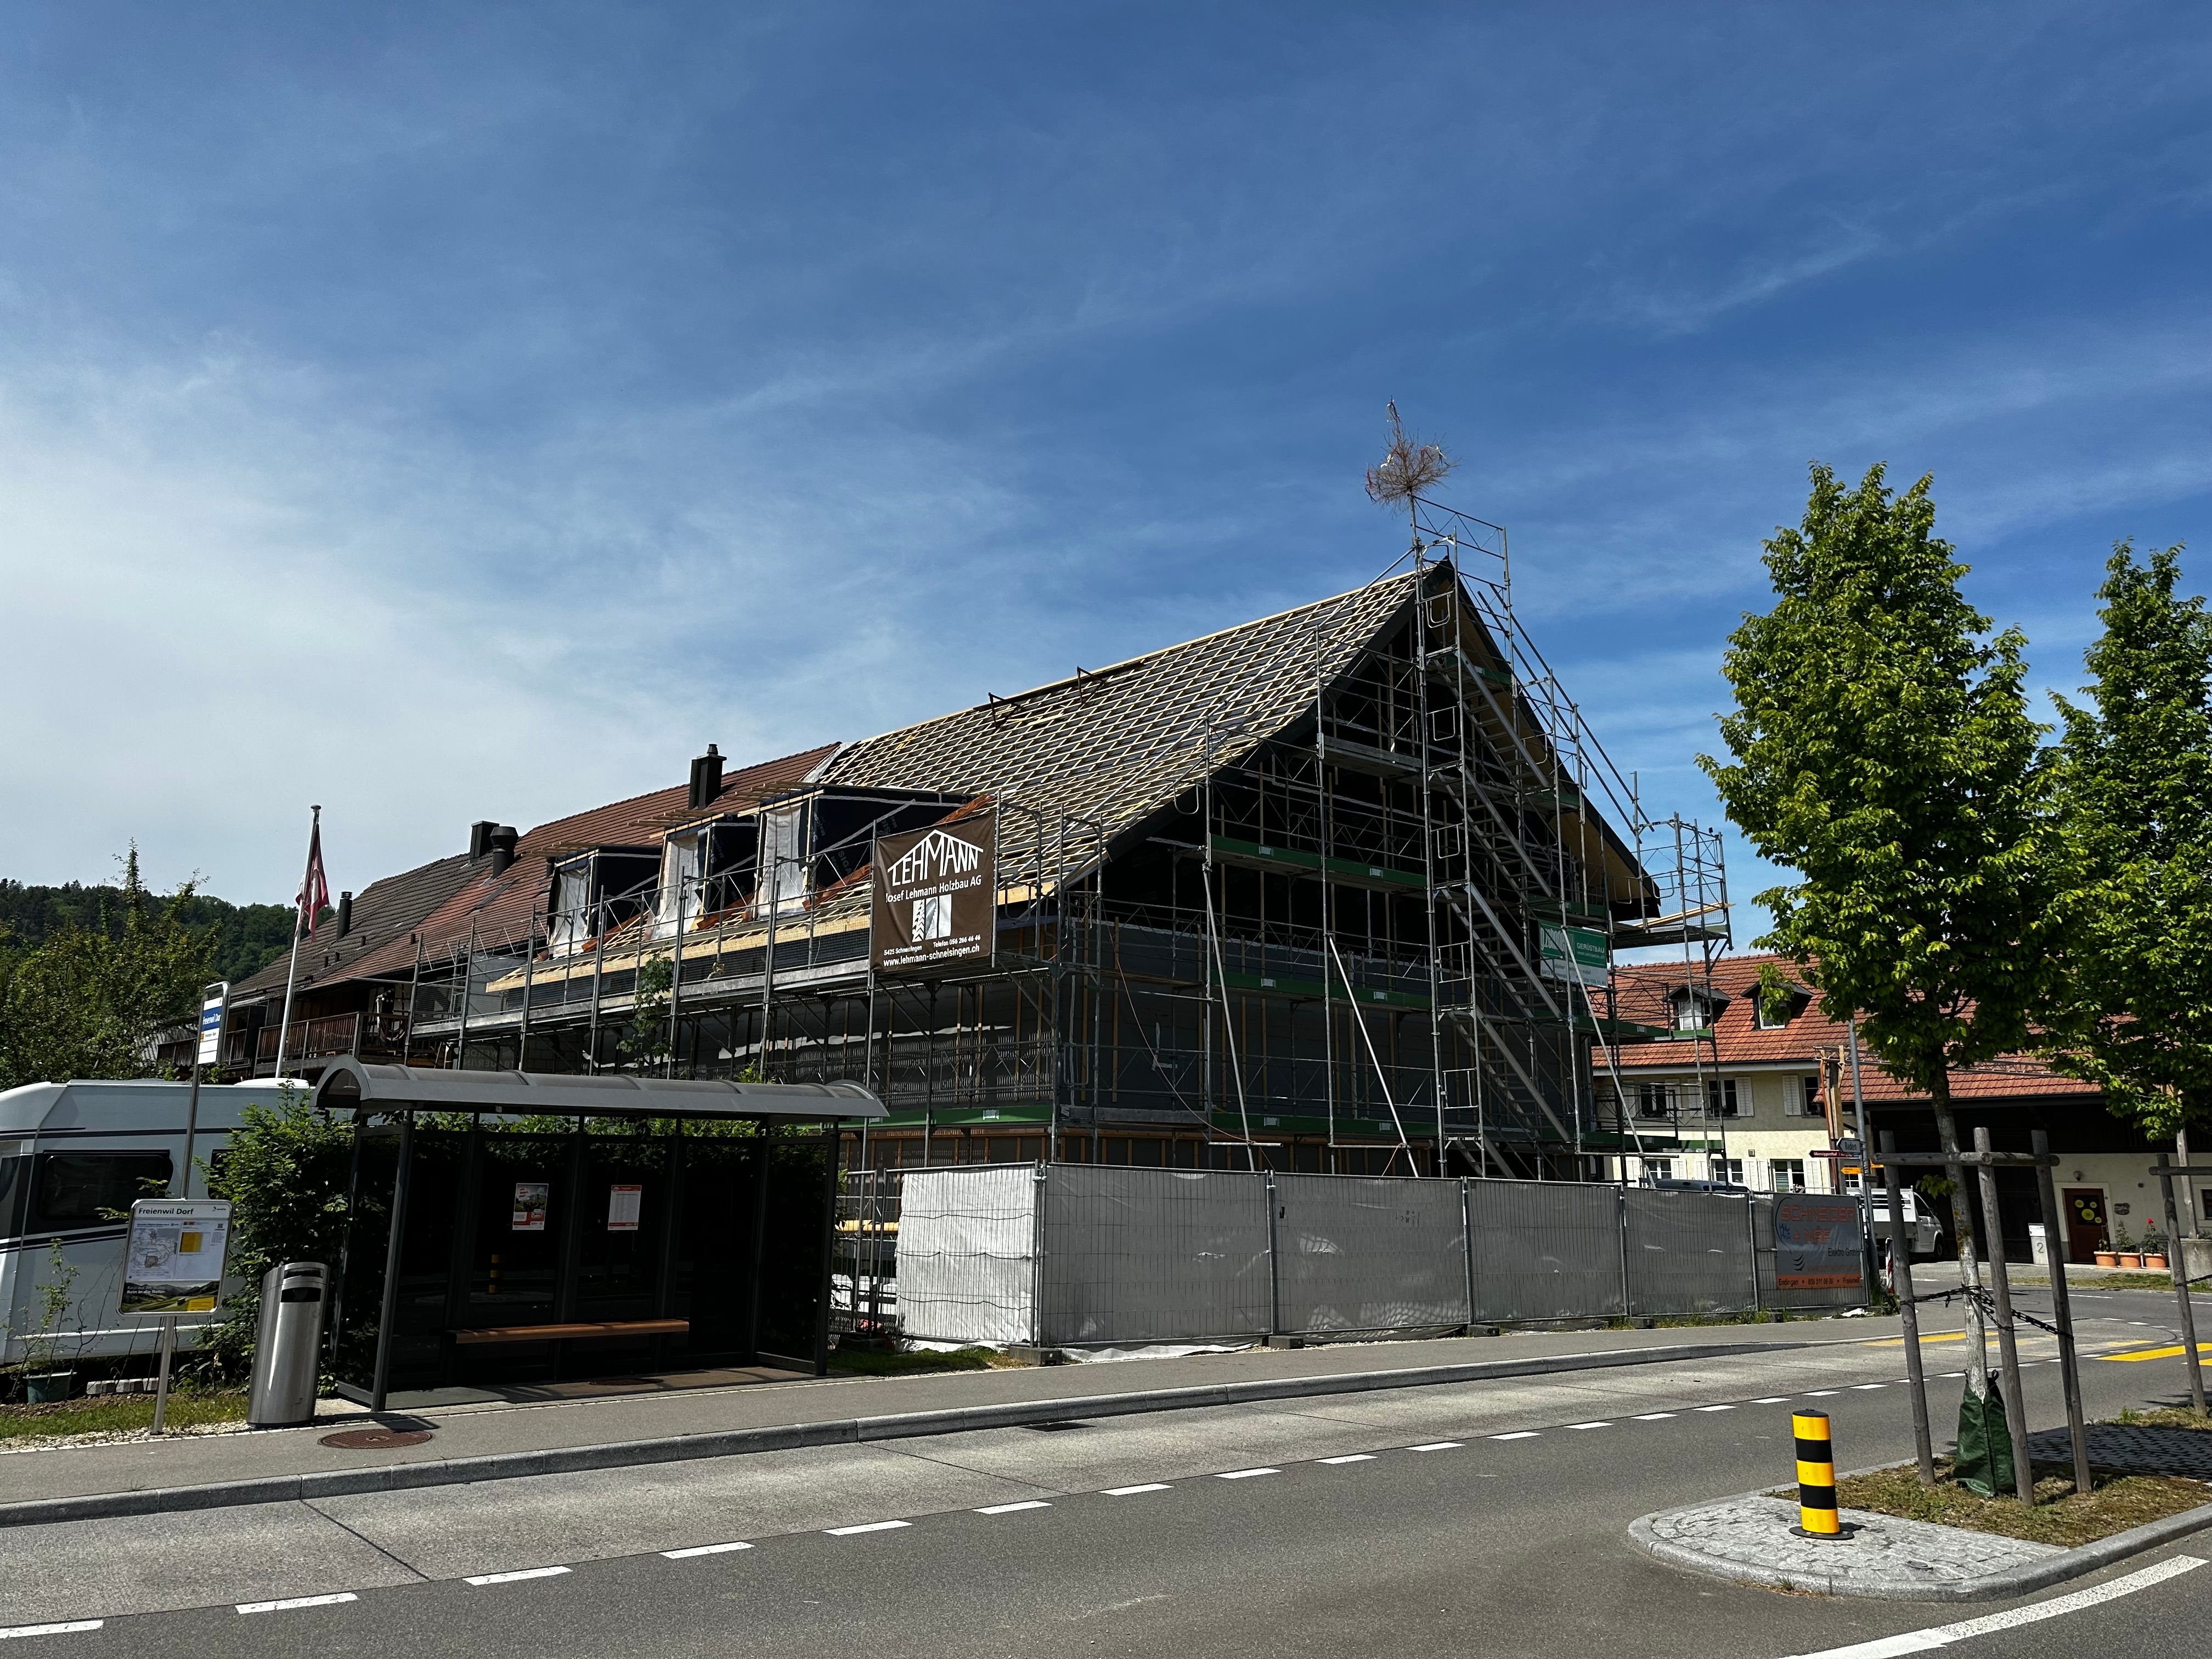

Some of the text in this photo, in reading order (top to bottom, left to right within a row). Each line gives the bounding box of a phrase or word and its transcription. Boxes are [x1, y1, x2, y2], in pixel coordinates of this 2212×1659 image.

[888, 830, 984, 886] LEHMANN
[886, 875, 981, 903] Josef Lehmann Holzbau AG
[883, 944, 980, 967] www.lehmann-schneisingen.ch
[1577, 943, 1605, 953] GERÜSTBAU
[1781, 1205, 1856, 1223] SCHNEIDER
[1804, 1225, 1831, 1245] NÄF
[1827, 1247, 1861, 1257] Elektro GmbH
[2036, 1242, 2044, 1254] 2
